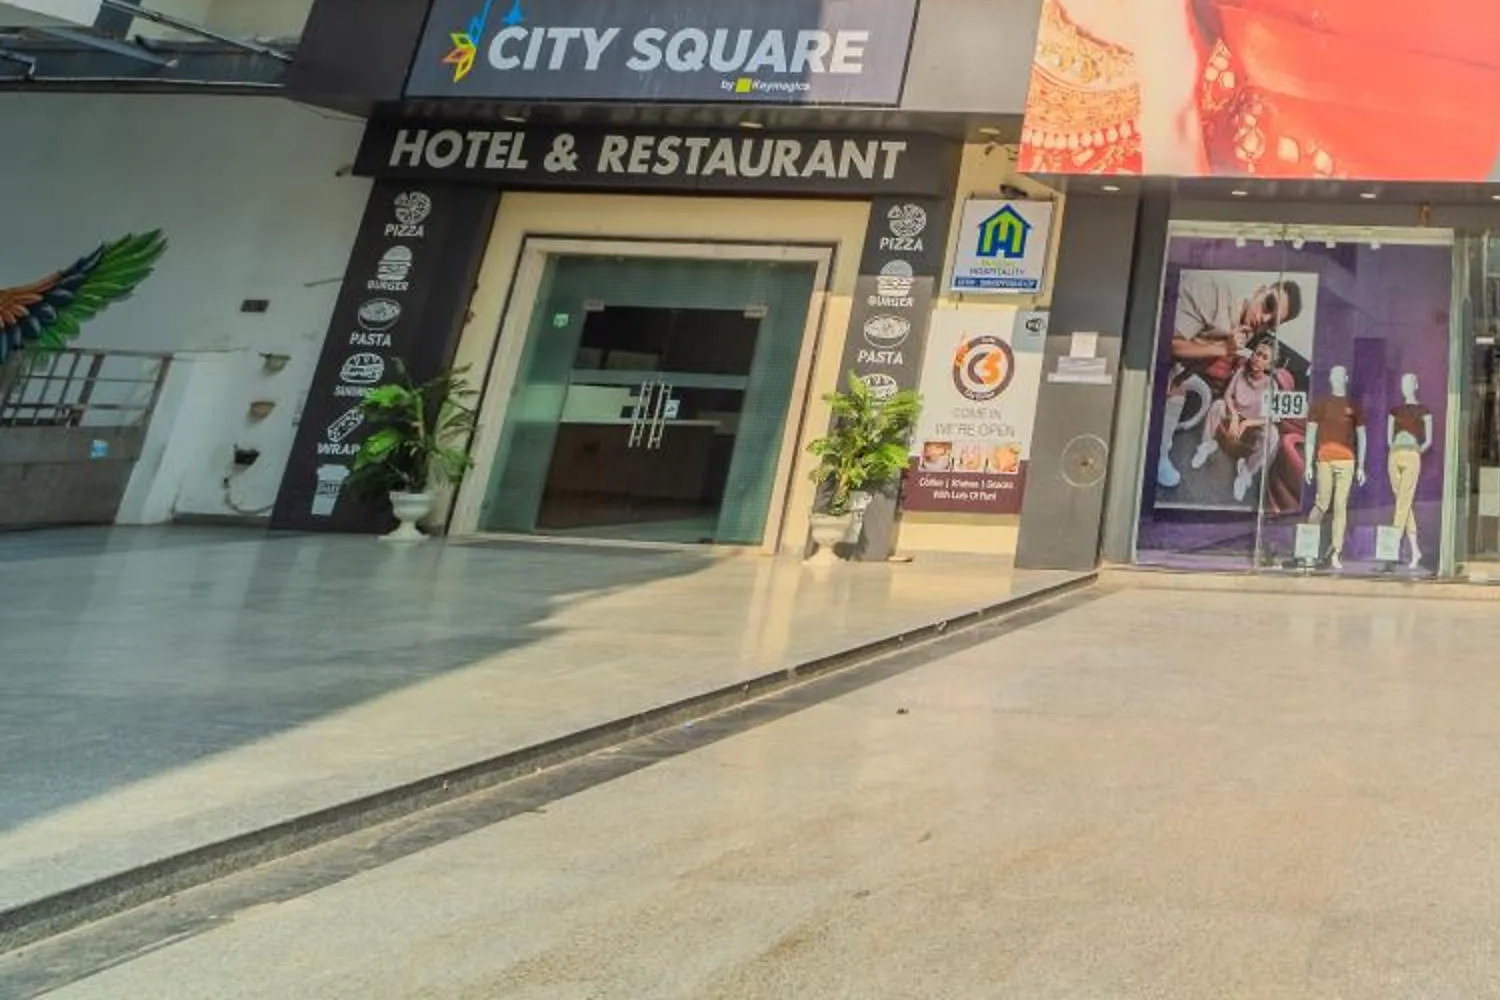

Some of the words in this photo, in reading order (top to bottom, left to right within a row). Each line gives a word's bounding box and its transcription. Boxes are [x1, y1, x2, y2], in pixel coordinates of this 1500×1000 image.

[488, 27, 620, 71] CITY
[626, 27, 869, 74] SQUARE
[720, 79, 735, 92] by
[389, 129, 529, 169] HOTEL
[543, 131, 579, 172] &
[598, 133, 906, 180] RESTAURANT
[384, 223, 425, 238] PIZZA
[879, 236, 923, 252] PIZZA
[367, 279, 409, 292] BURGER
[350, 333, 392, 348] PASTA
[857, 351, 904, 366] PASTA
[978, 423, 1016, 438] OPEN
[317, 442, 361, 456] WRAP
